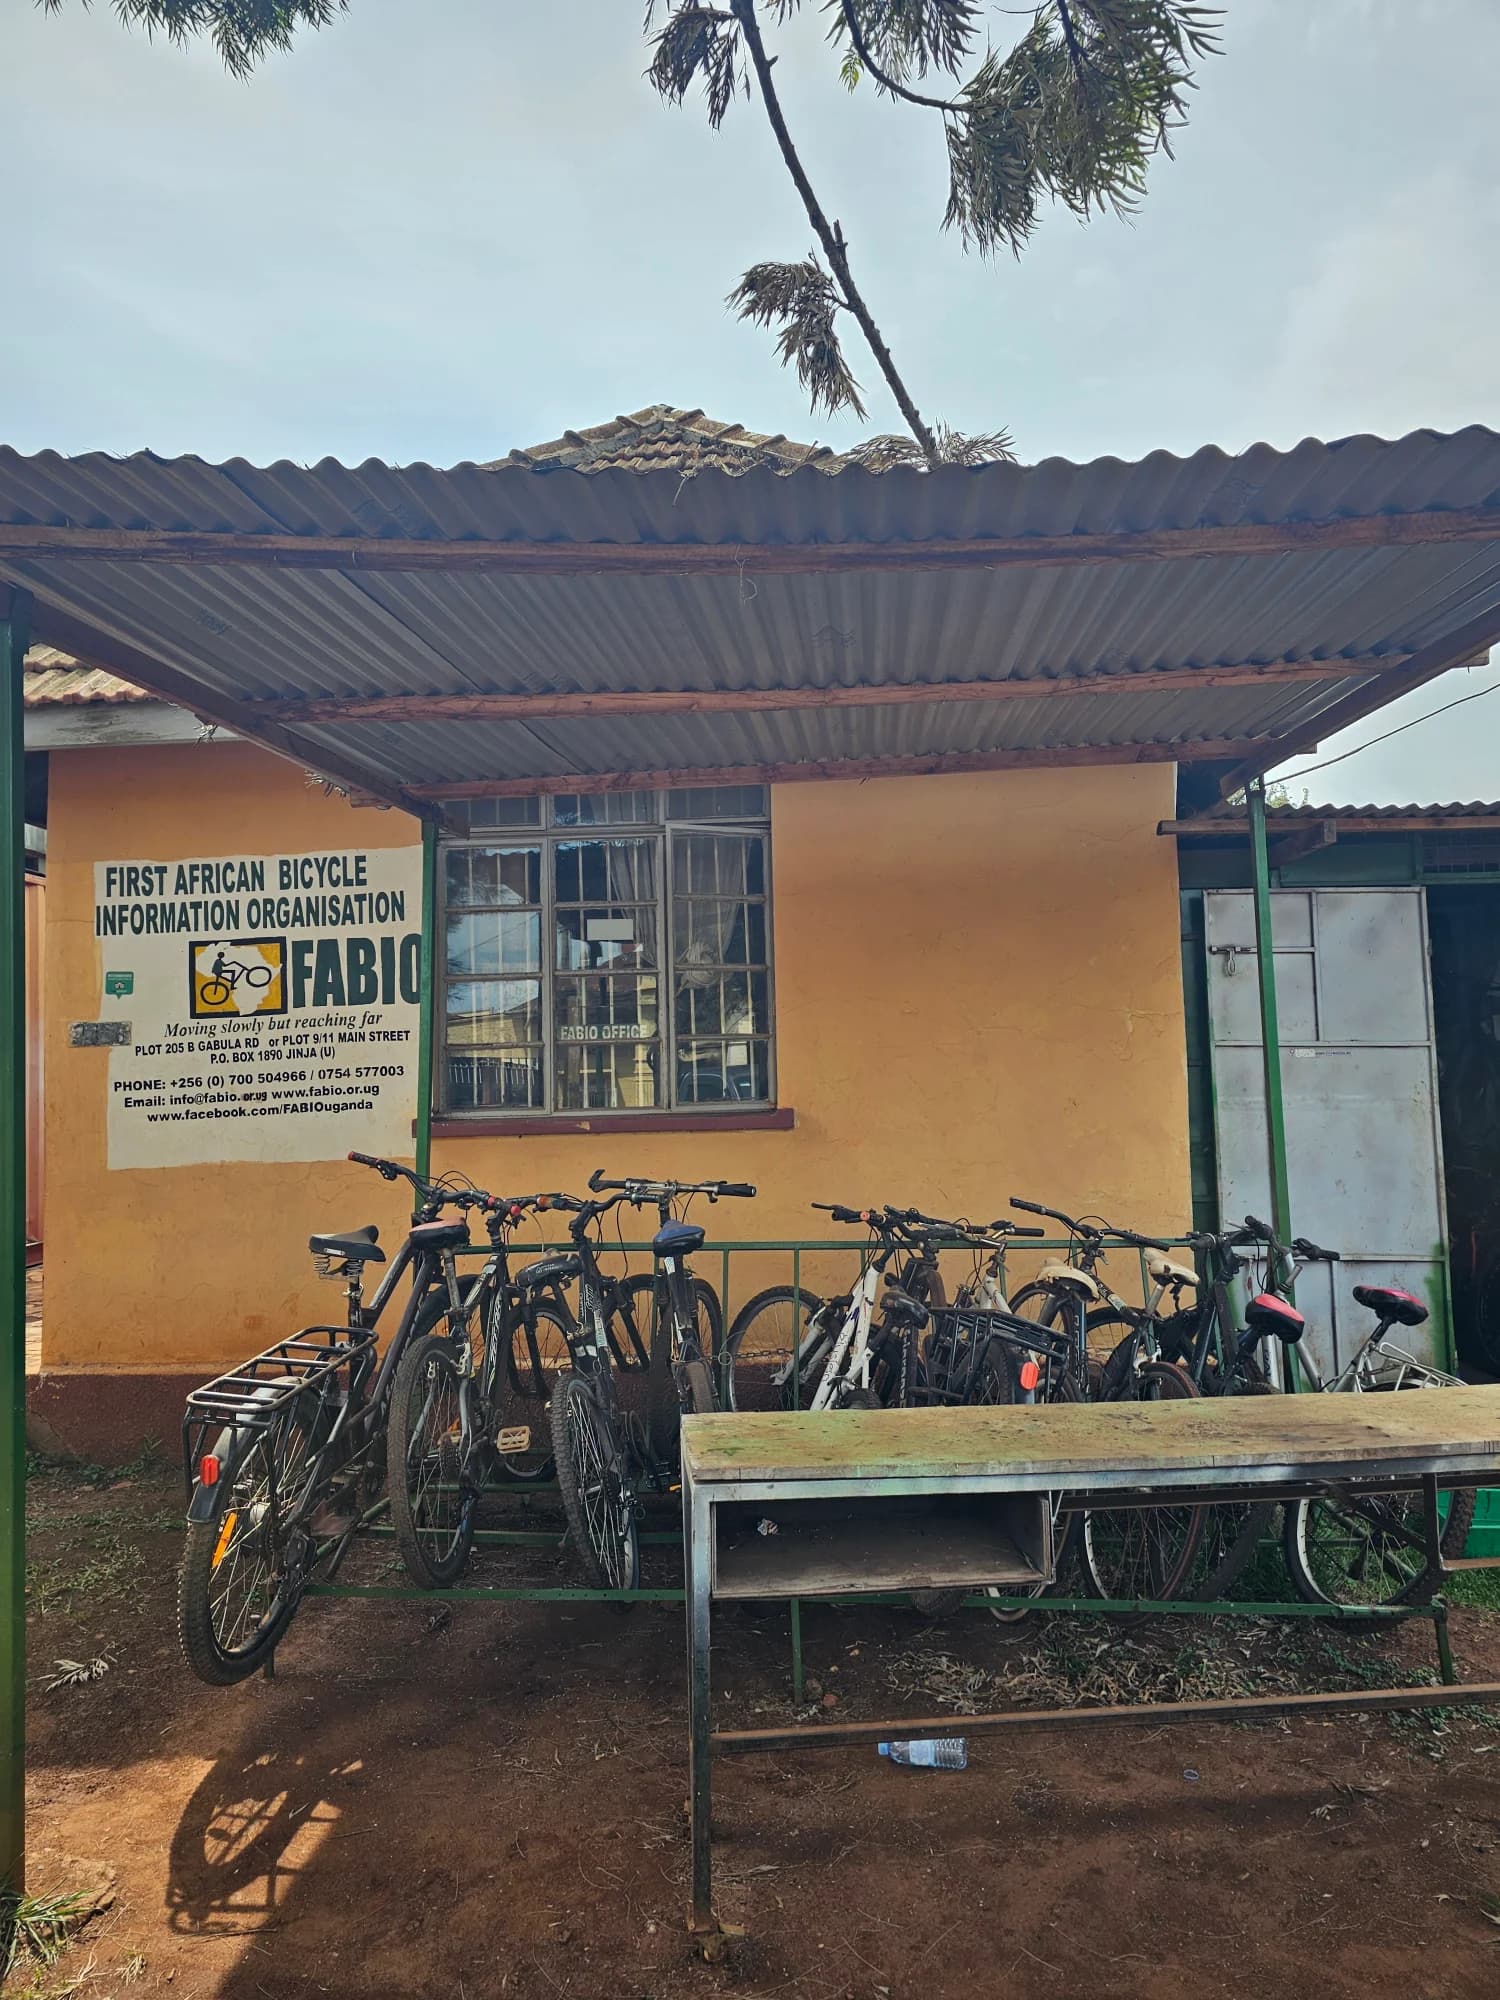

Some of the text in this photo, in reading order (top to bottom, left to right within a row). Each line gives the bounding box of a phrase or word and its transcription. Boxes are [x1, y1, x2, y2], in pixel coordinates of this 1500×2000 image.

[106, 855, 368, 898] FIRST AFRICAN BICYCLE
[96, 890, 405, 937] INFORMATION ORGANISATION
[291, 933, 421, 1008] FABIO
[164, 1010, 383, 1038] Moving slowly but reaching far
[560, 1024, 648, 1040] FABIO OFFICE
[135, 1030, 411, 1056] PLOT 205 B GABULA RD or PLOT 9/11 MAIN STREET
[210, 1046, 336, 1064] P.O. BOX 1890 JINJA (U)
[114, 1079, 167, 1092] PHONE:
[170, 1076, 203, 1089] +256
[207, 1075, 225, 1089] (0)
[228, 1074, 254, 1086] 700
[257, 1070, 307, 1084] 504966
[318, 1067, 351, 1080] 0754
[354, 1065, 405, 1078] 577003
[124, 1096, 166, 1108] Email:
[271, 1085, 380, 1101] www.fabio.or.ug
